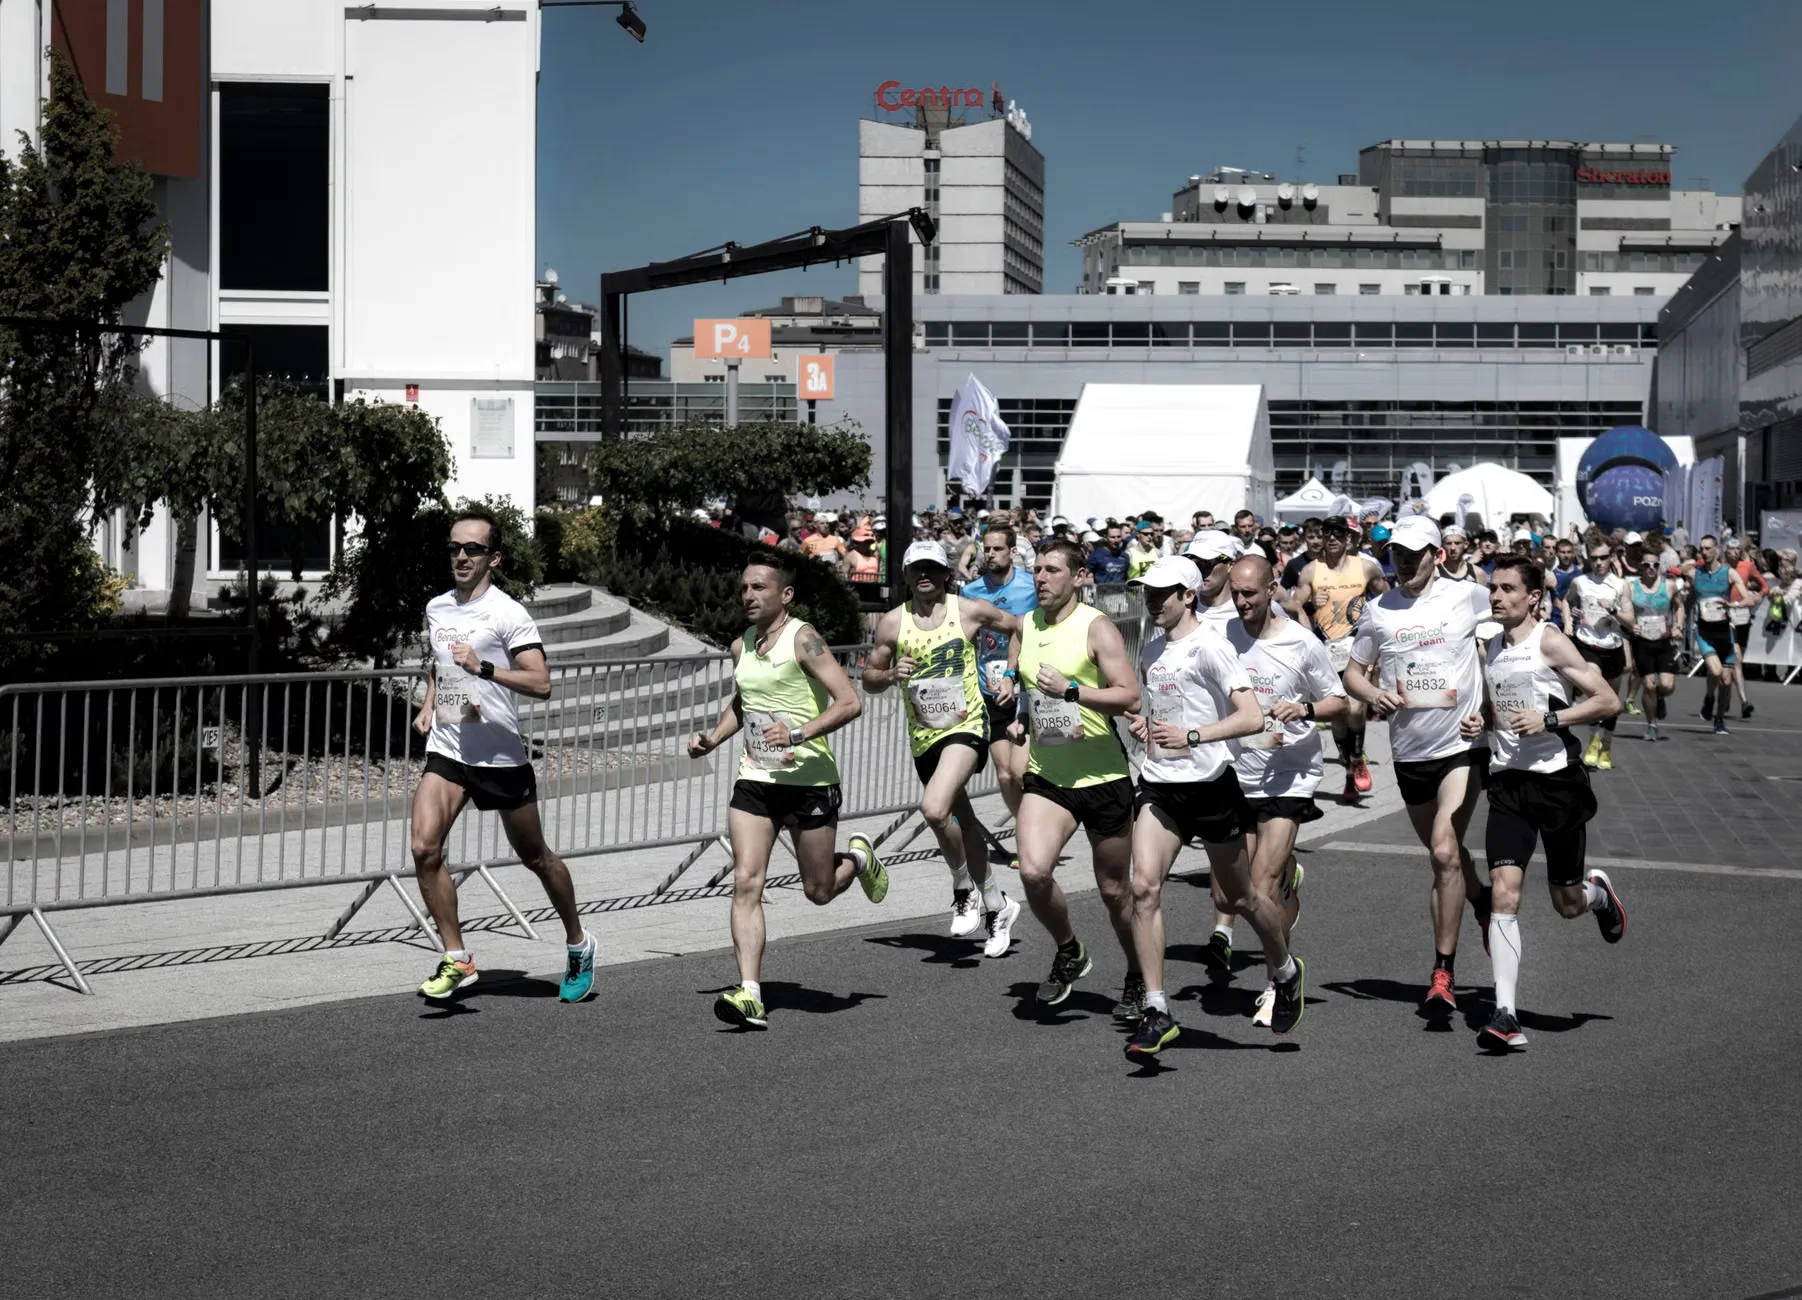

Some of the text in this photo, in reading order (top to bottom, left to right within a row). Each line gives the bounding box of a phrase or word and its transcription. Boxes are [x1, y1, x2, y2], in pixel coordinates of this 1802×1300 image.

[875, 80, 984, 112] Centra
[1577, 166, 1671, 184] Sheraton
[437, 631, 470, 642] Benecol
[1400, 621, 1444, 643] Benecol
[1418, 637, 1446, 647] team
[1249, 673, 1275, 687] ecol
[1406, 678, 1446, 691] 84832
[1159, 683, 1177, 691] team
[1254, 686, 1274, 695] eam
[437, 693, 470, 706] 84875
[920, 701, 957, 714] 85064
[1035, 716, 1072, 729] 30858
